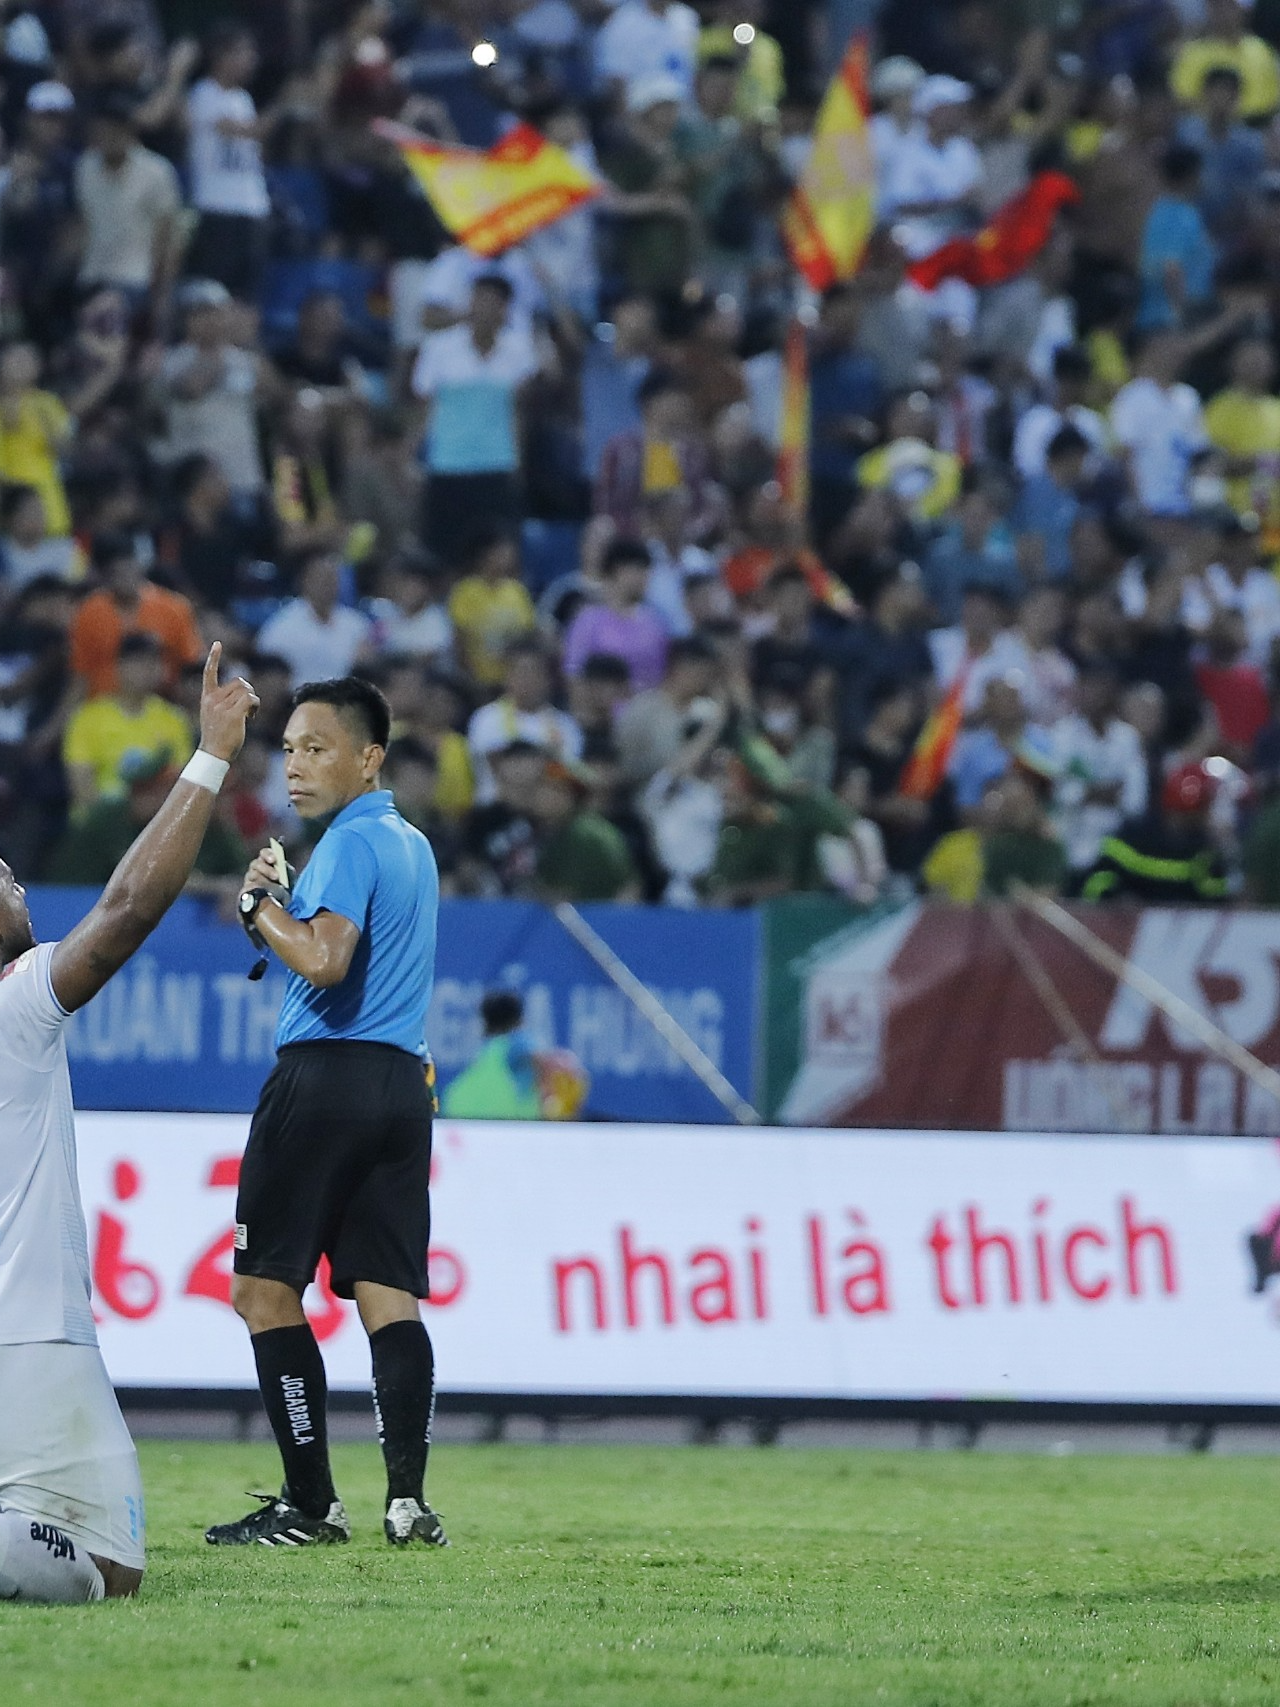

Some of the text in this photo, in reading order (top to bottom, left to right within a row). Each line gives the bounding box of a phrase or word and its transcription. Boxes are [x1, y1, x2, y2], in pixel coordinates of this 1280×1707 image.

[1098, 906, 1280, 1049] K5
[550, 1192, 1183, 1334] nhai là thích
[279, 1374, 317, 1446] JOGARBOLA
